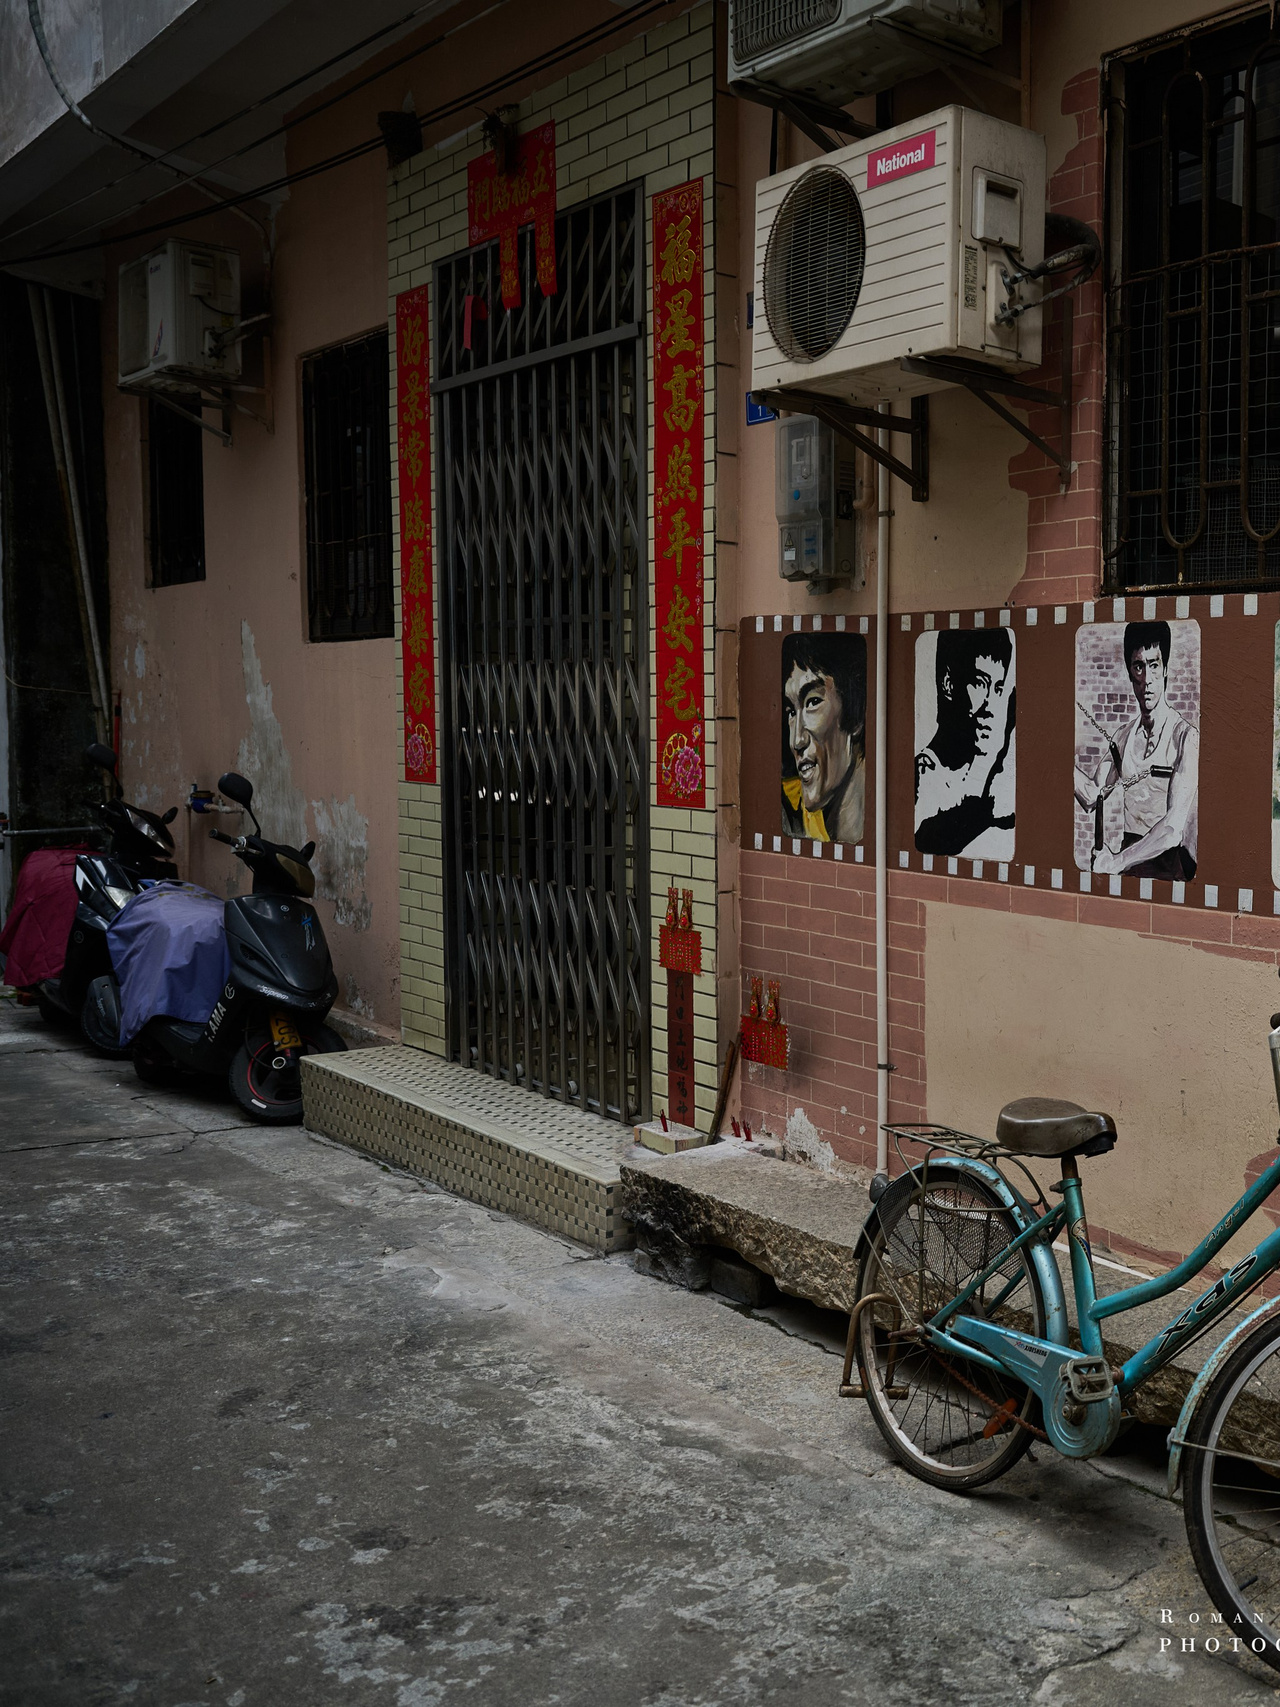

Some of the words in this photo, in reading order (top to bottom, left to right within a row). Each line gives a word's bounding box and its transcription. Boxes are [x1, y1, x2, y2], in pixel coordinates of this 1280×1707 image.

[877, 143, 925, 176] National
[659, 214, 699, 722] 福星高照平安宅
